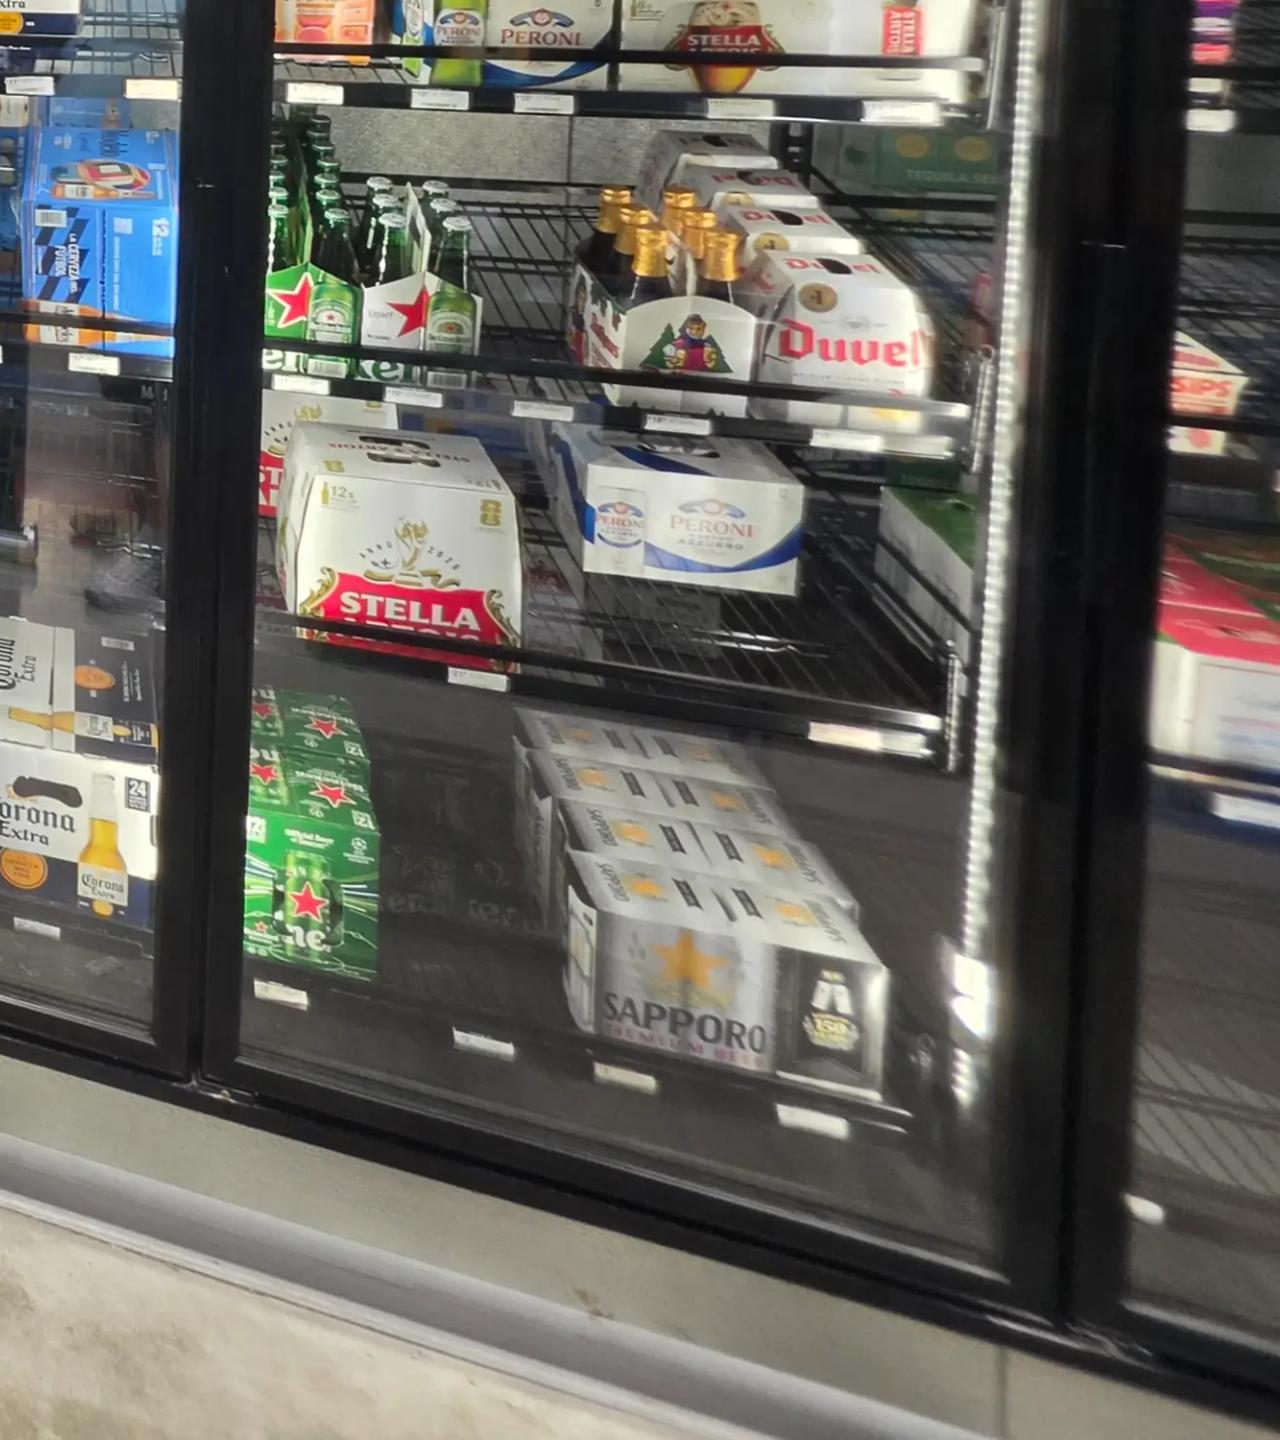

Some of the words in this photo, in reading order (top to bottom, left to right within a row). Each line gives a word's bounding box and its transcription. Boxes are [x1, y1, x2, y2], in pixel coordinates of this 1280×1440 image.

[501, 28, 584, 47] PERONI
[687, 33, 761, 48] STELLA
[778, 317, 922, 368] Duvel
[670, 513, 756, 538] PERONI
[340, 590, 481, 632] STELLA
[17, 654, 37, 683] Extra
[129, 779, 147, 797] 24
[82, 872, 124, 894] Corona
[603, 991, 767, 1054] SAPPORO
